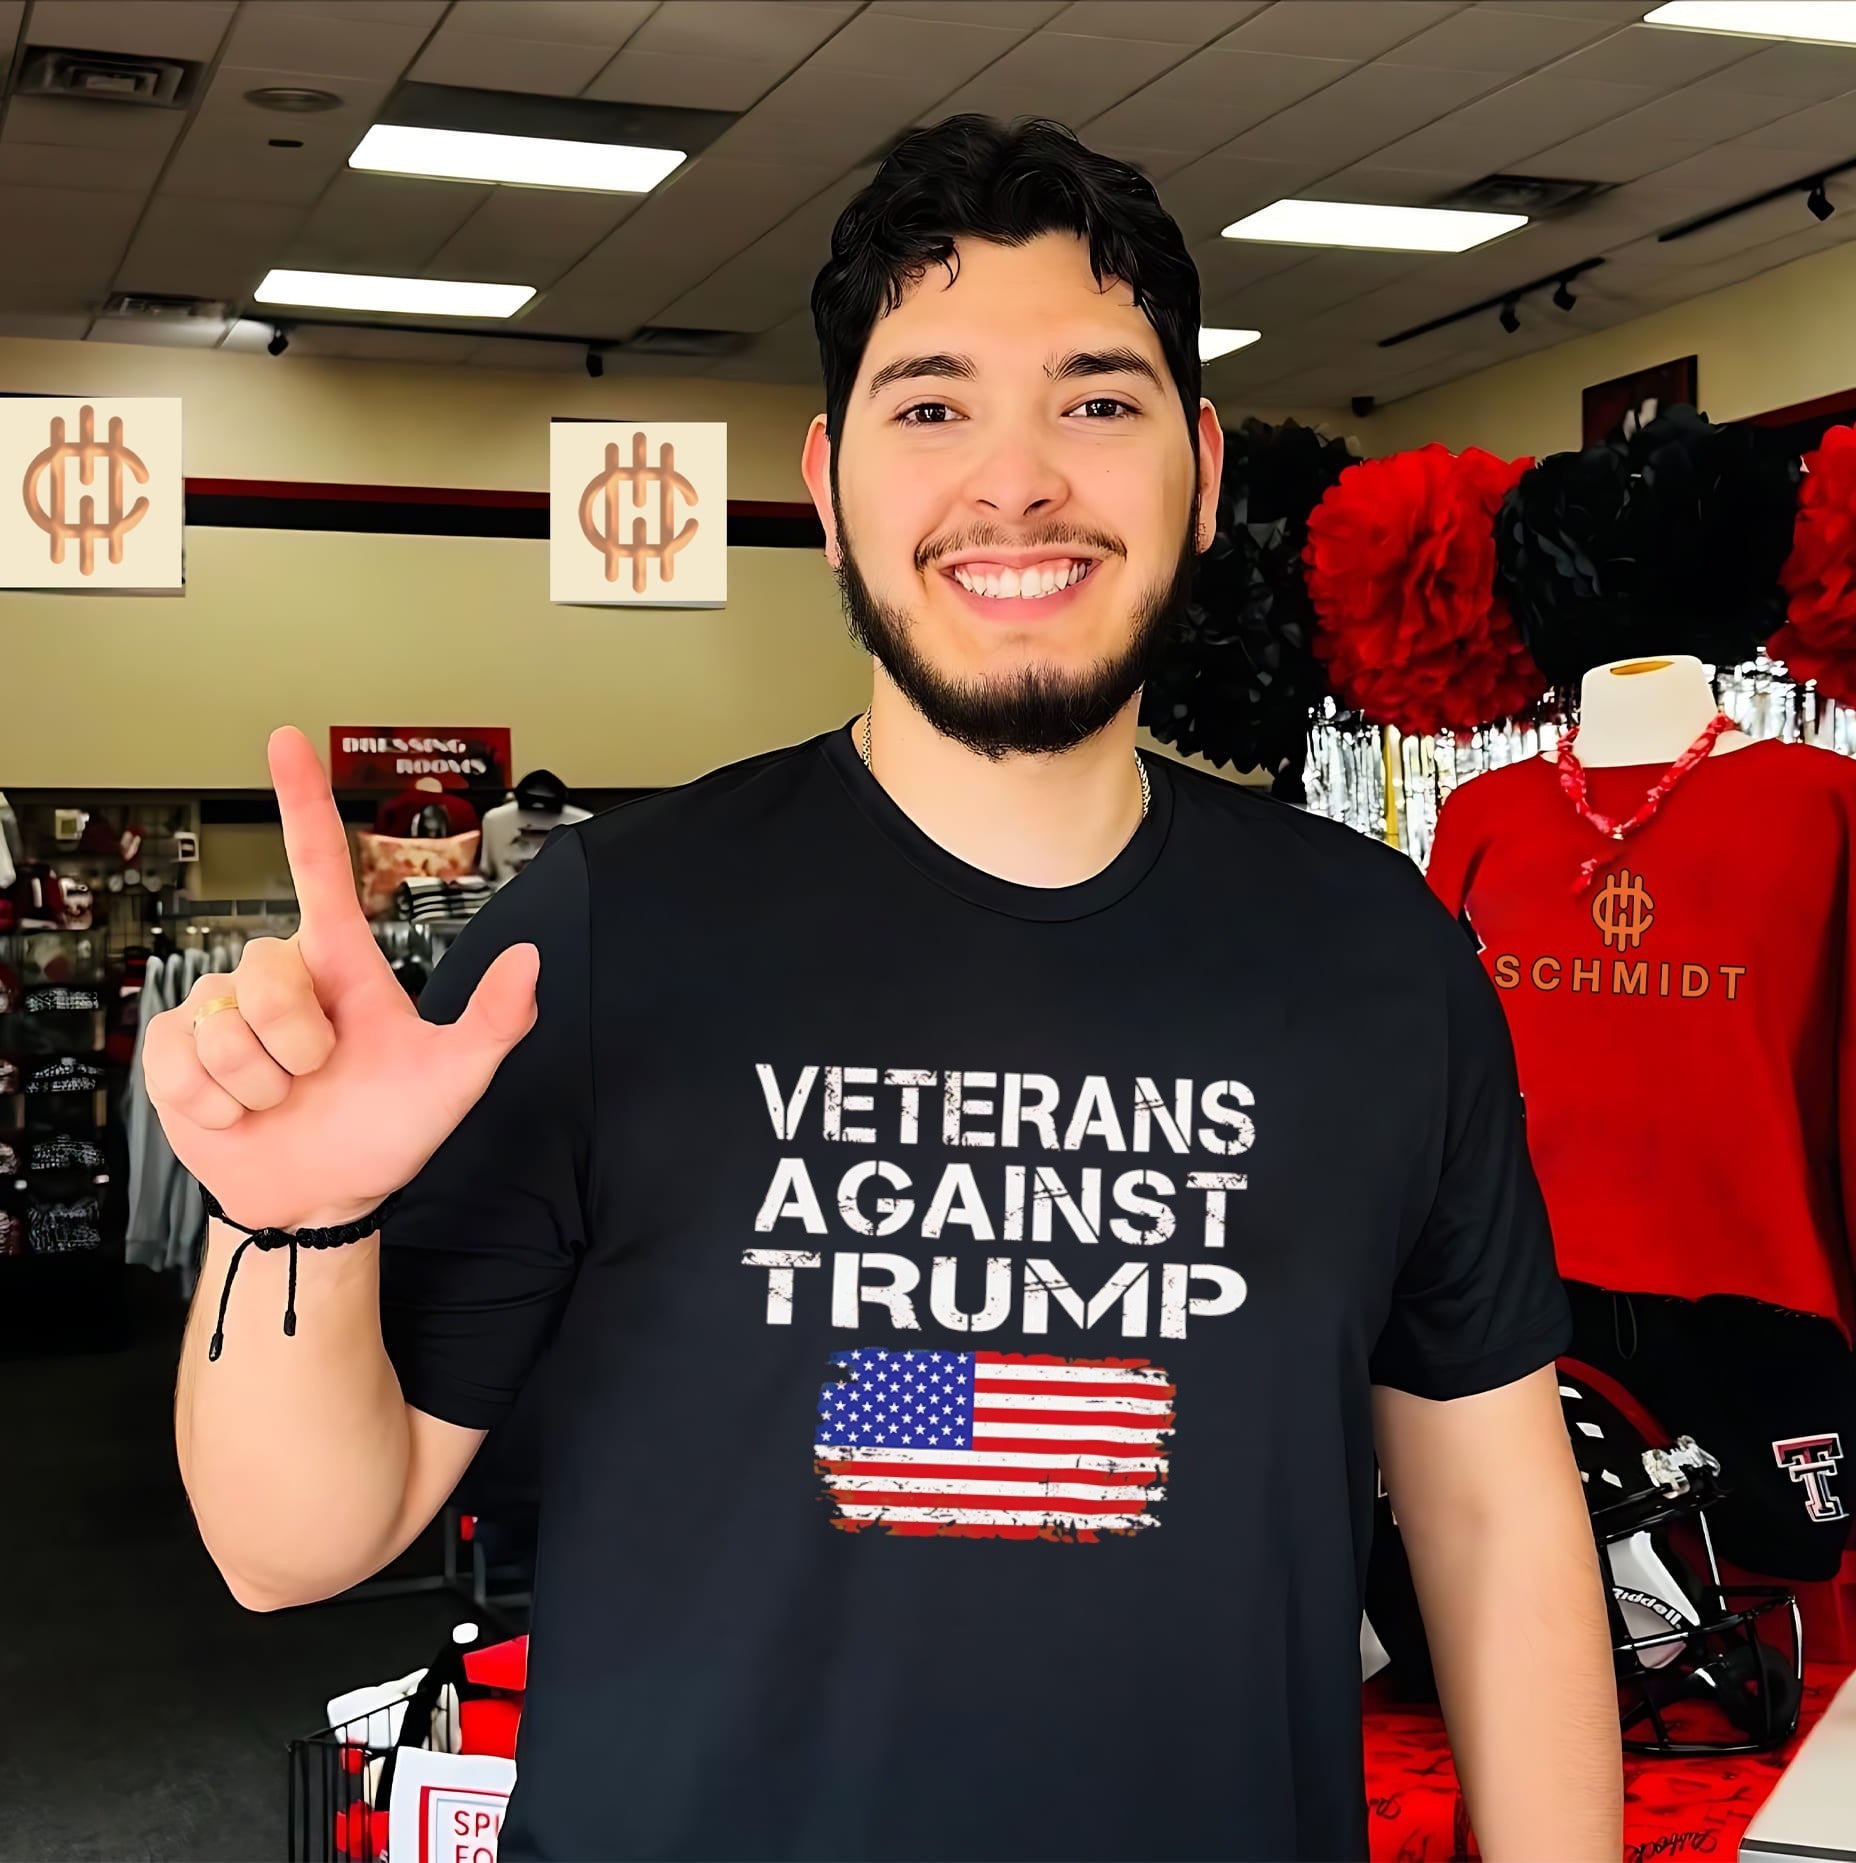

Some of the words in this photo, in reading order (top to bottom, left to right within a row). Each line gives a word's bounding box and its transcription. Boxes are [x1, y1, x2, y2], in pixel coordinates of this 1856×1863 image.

[342, 737, 467, 754] DRESSING
[396, 758, 487, 775] ROOMS
[1494, 953, 1747, 1000] SCHMIDT
[754, 1063, 1256, 1156] VETERANS
[754, 1157, 1249, 1249] AGAINST
[740, 1248, 1249, 1340] TRUMP
